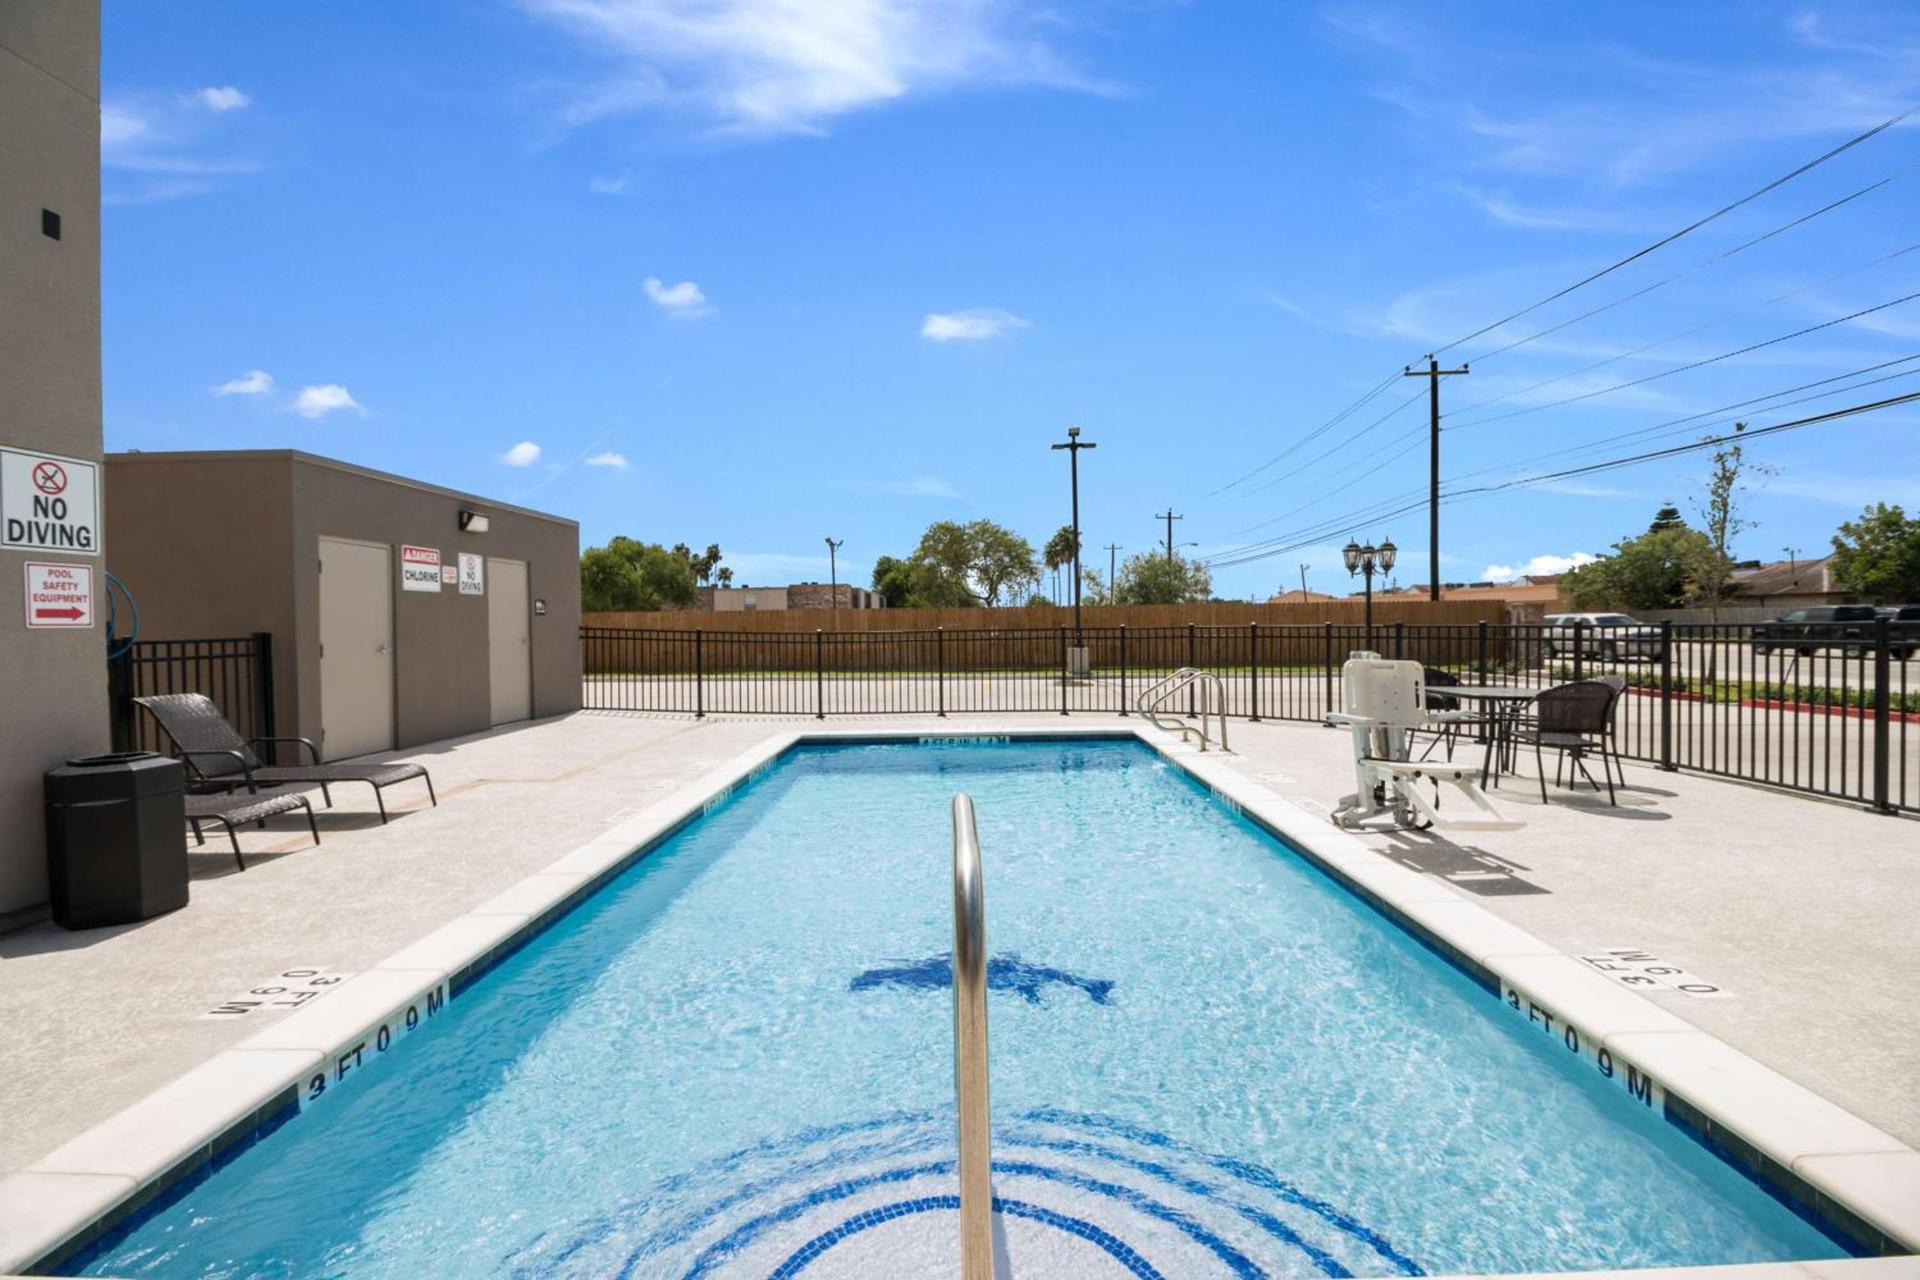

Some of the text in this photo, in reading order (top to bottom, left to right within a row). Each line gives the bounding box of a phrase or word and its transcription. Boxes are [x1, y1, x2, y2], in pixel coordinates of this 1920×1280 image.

[33, 495, 67, 520] NO
[8, 519, 91, 548] DIVING
[412, 550, 437, 562] DANGER
[48, 569, 73, 579] POOL
[405, 569, 438, 583] CHLORINE
[467, 571, 476, 581] NO
[42, 581, 79, 592] SAFETY
[461, 581, 481, 592] DIVING
[32, 593, 88, 604] EQUIPMENT
[1608, 950, 1658, 962] M
[1582, 955, 1656, 985] 3 FT
[273, 977, 341, 1008] 3 FT
[209, 1001, 264, 1015] M
[309, 1073, 326, 1101] 3
[337, 1042, 366, 1081] FT
[427, 985, 444, 1017] M
[1507, 989, 1521, 1011] 3
[1529, 1002, 1554, 1033] FT
[1627, 1063, 1652, 1108] M
